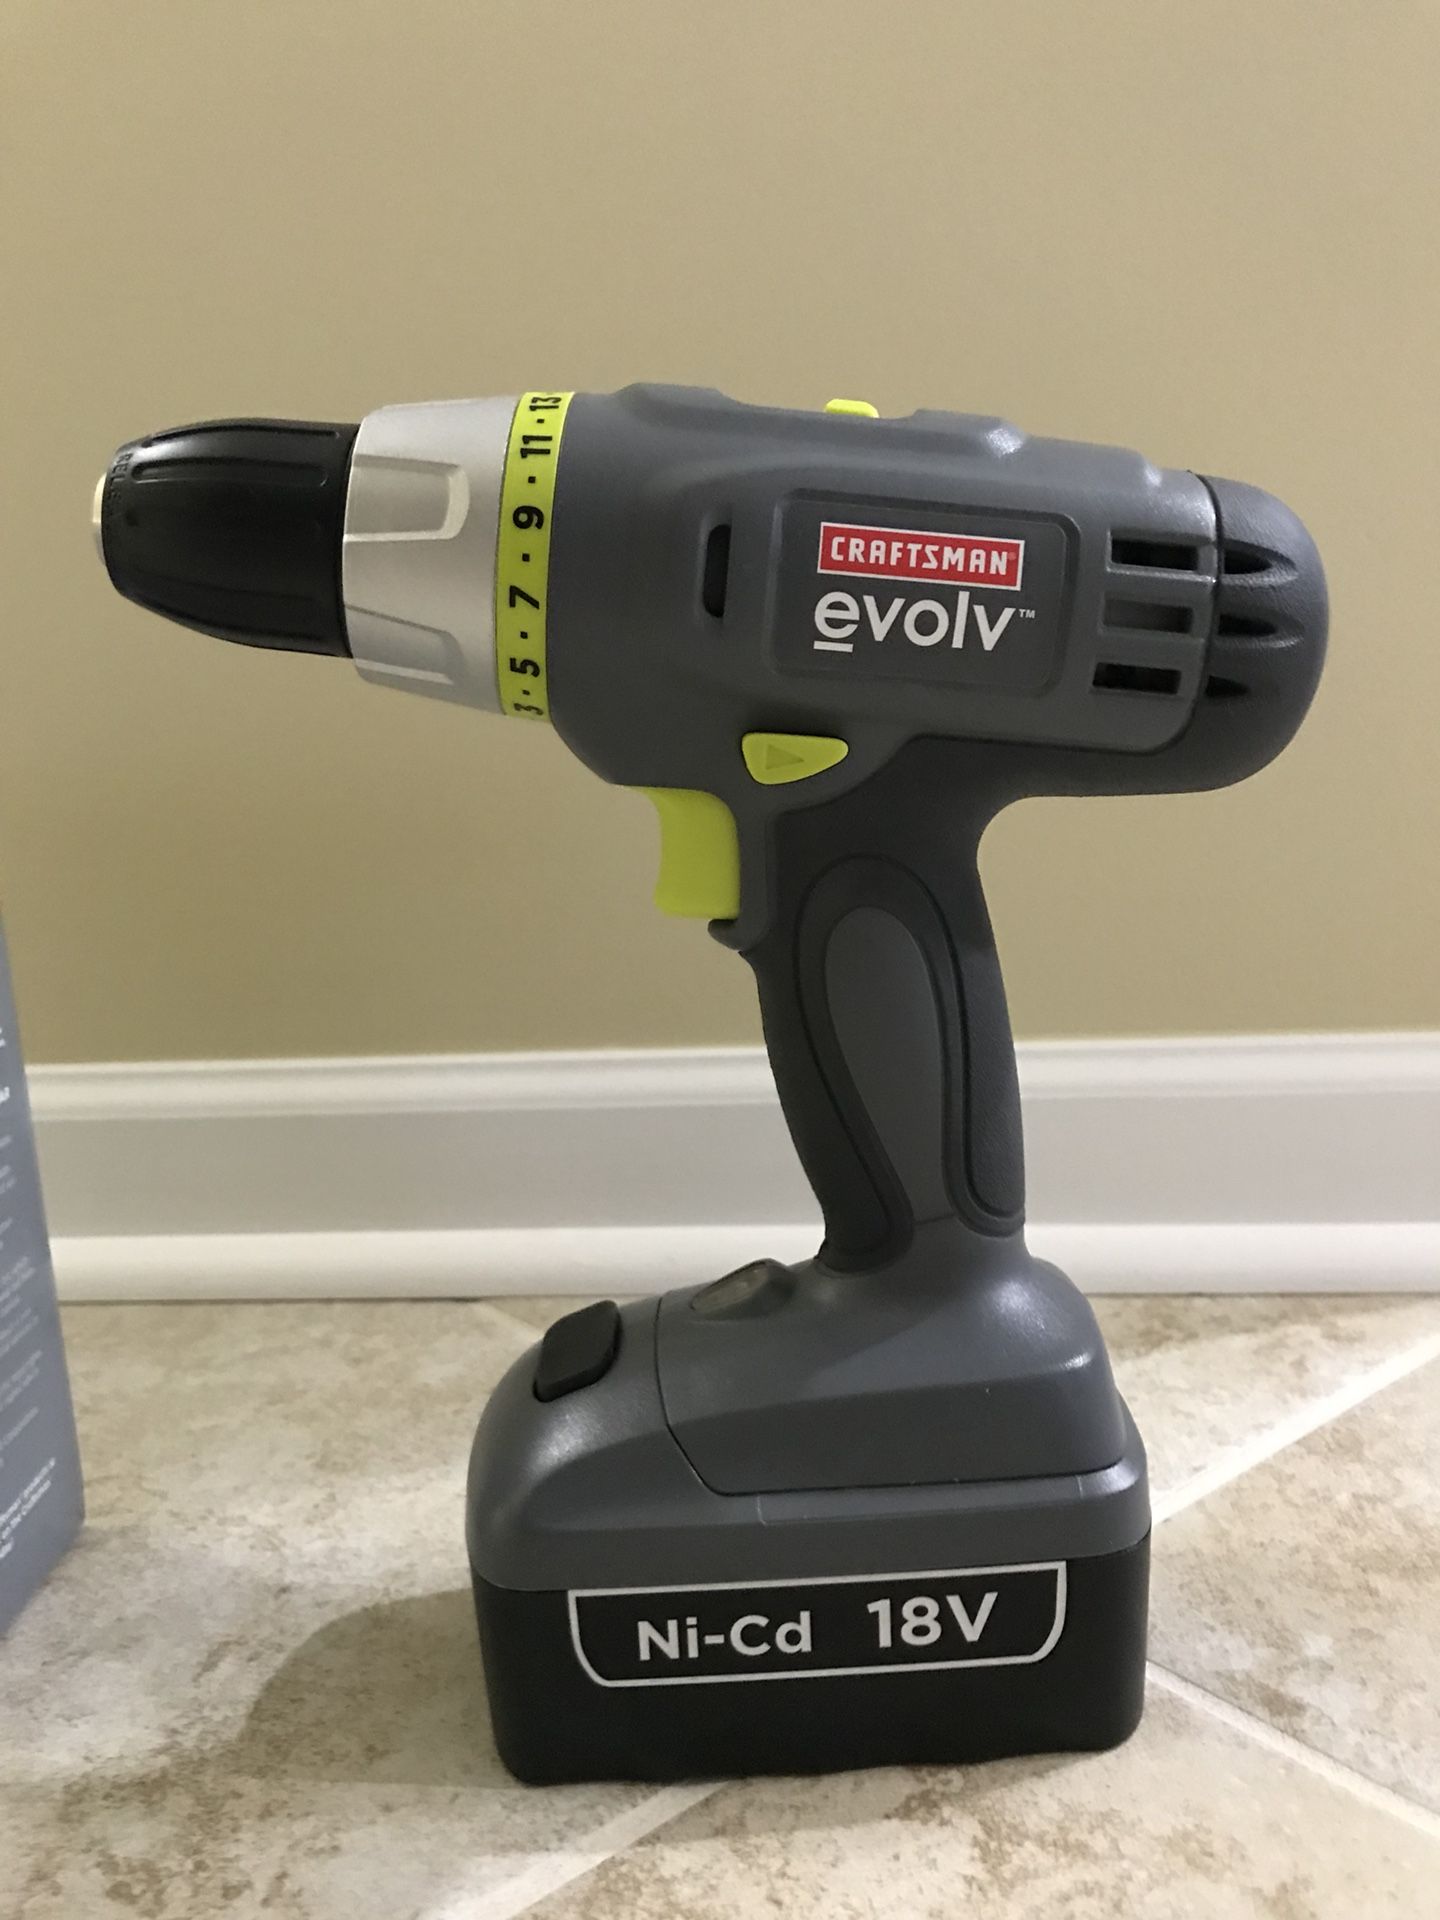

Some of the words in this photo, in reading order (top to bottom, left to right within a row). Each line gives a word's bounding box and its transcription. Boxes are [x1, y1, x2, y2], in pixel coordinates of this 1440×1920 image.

[528, 395, 562, 413] 13
[519, 434, 553, 459] 11
[511, 504, 545, 530] 9
[831, 536, 1008, 575] CRAFTSMAN
[508, 584, 541, 610] 7
[813, 591, 1016, 652] evolv
[509, 656, 541, 679] 5
[513, 702, 544, 717] 3
[636, 1610, 813, 1662] Ni-Cd
[866, 1591, 999, 1649] 18V
